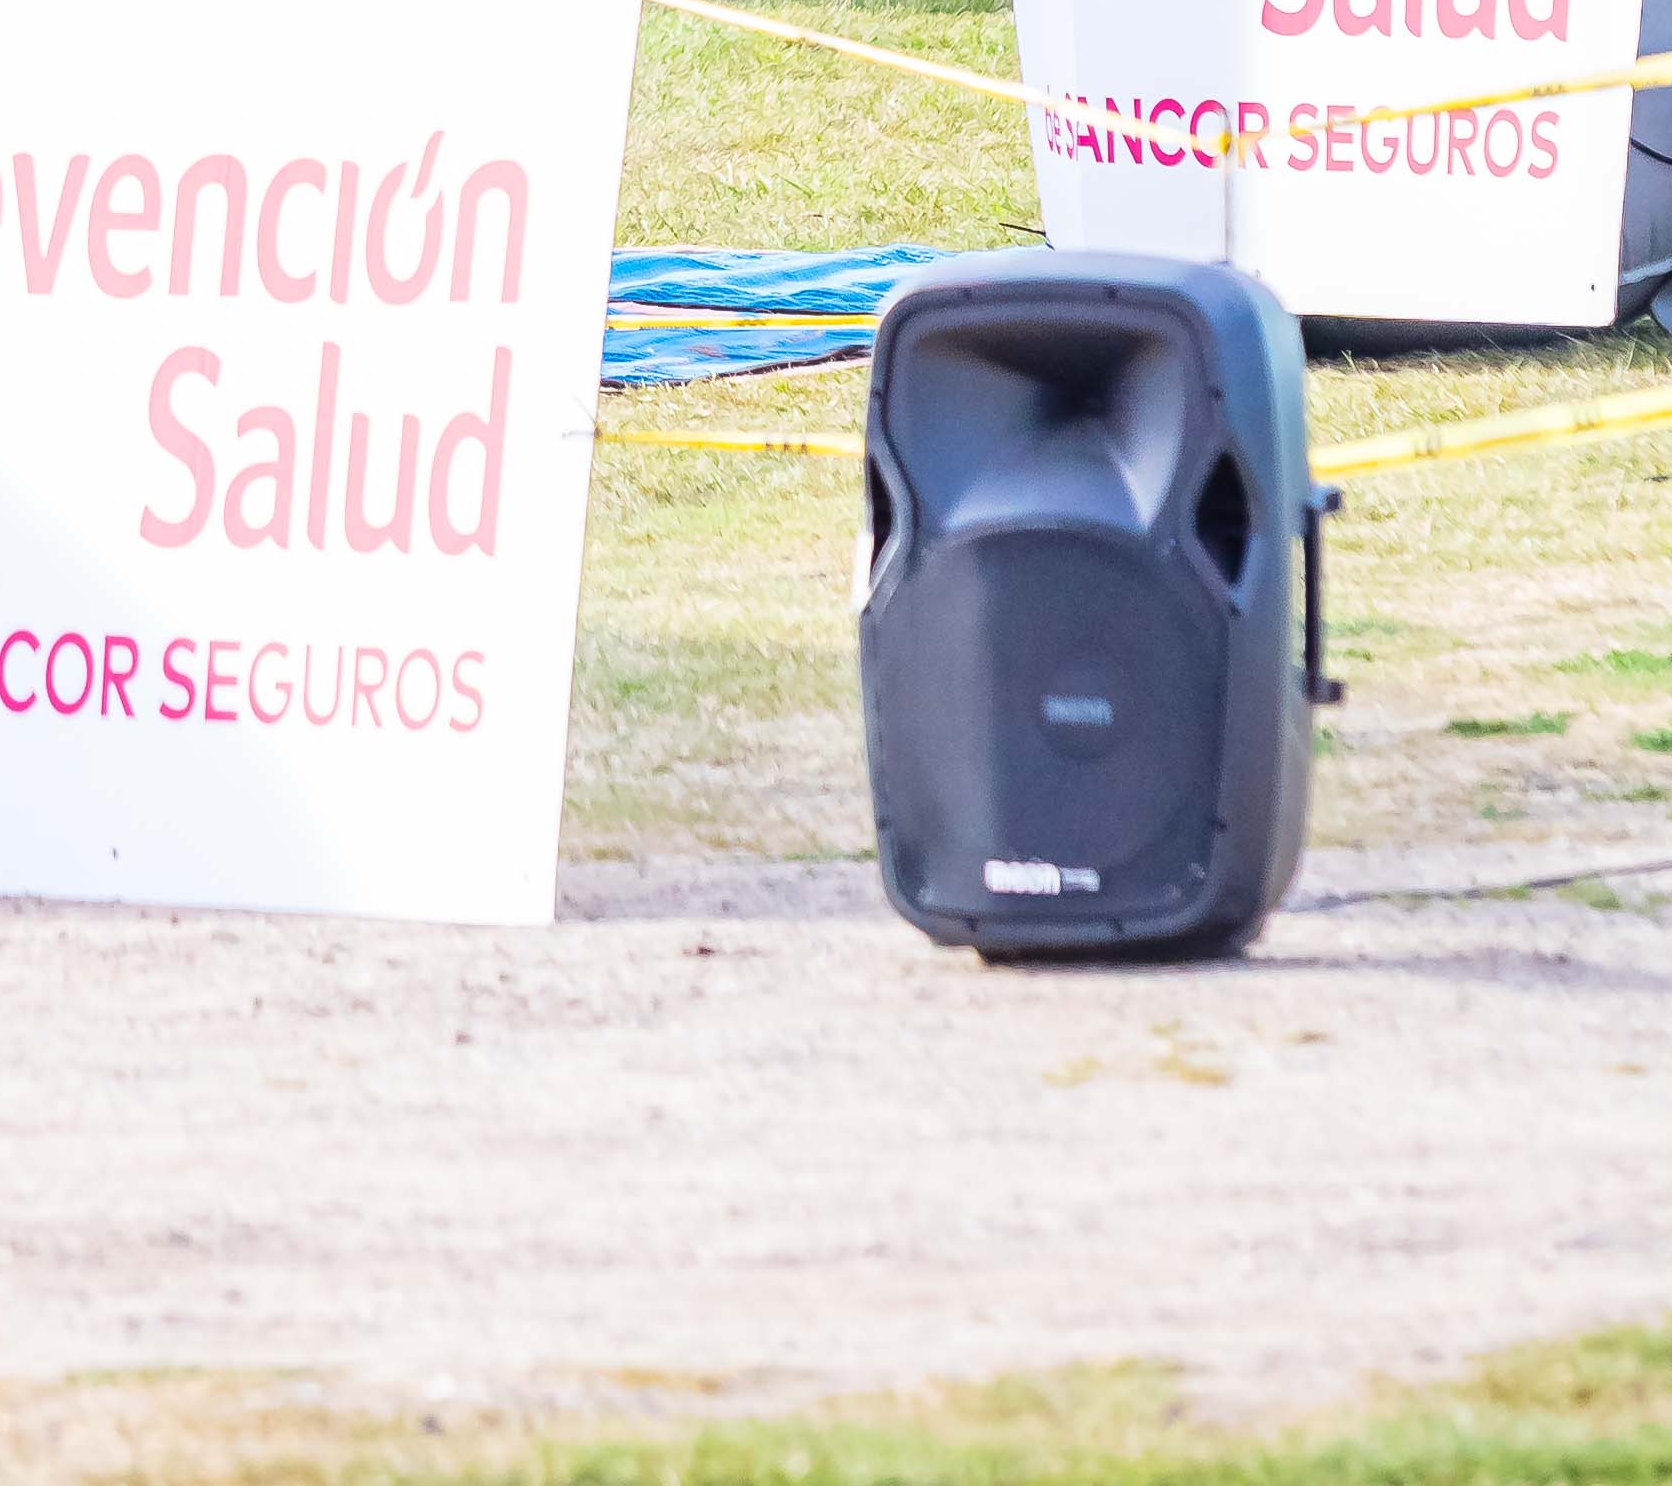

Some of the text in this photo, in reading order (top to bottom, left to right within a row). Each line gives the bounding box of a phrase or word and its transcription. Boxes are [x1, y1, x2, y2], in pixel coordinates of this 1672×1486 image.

[1064, 93, 1270, 171] SANCOR
[1286, 102, 1561, 180] SEGUROS
[141, 342, 511, 555] Salud
[158, 636, 483, 732] SEGUROS
